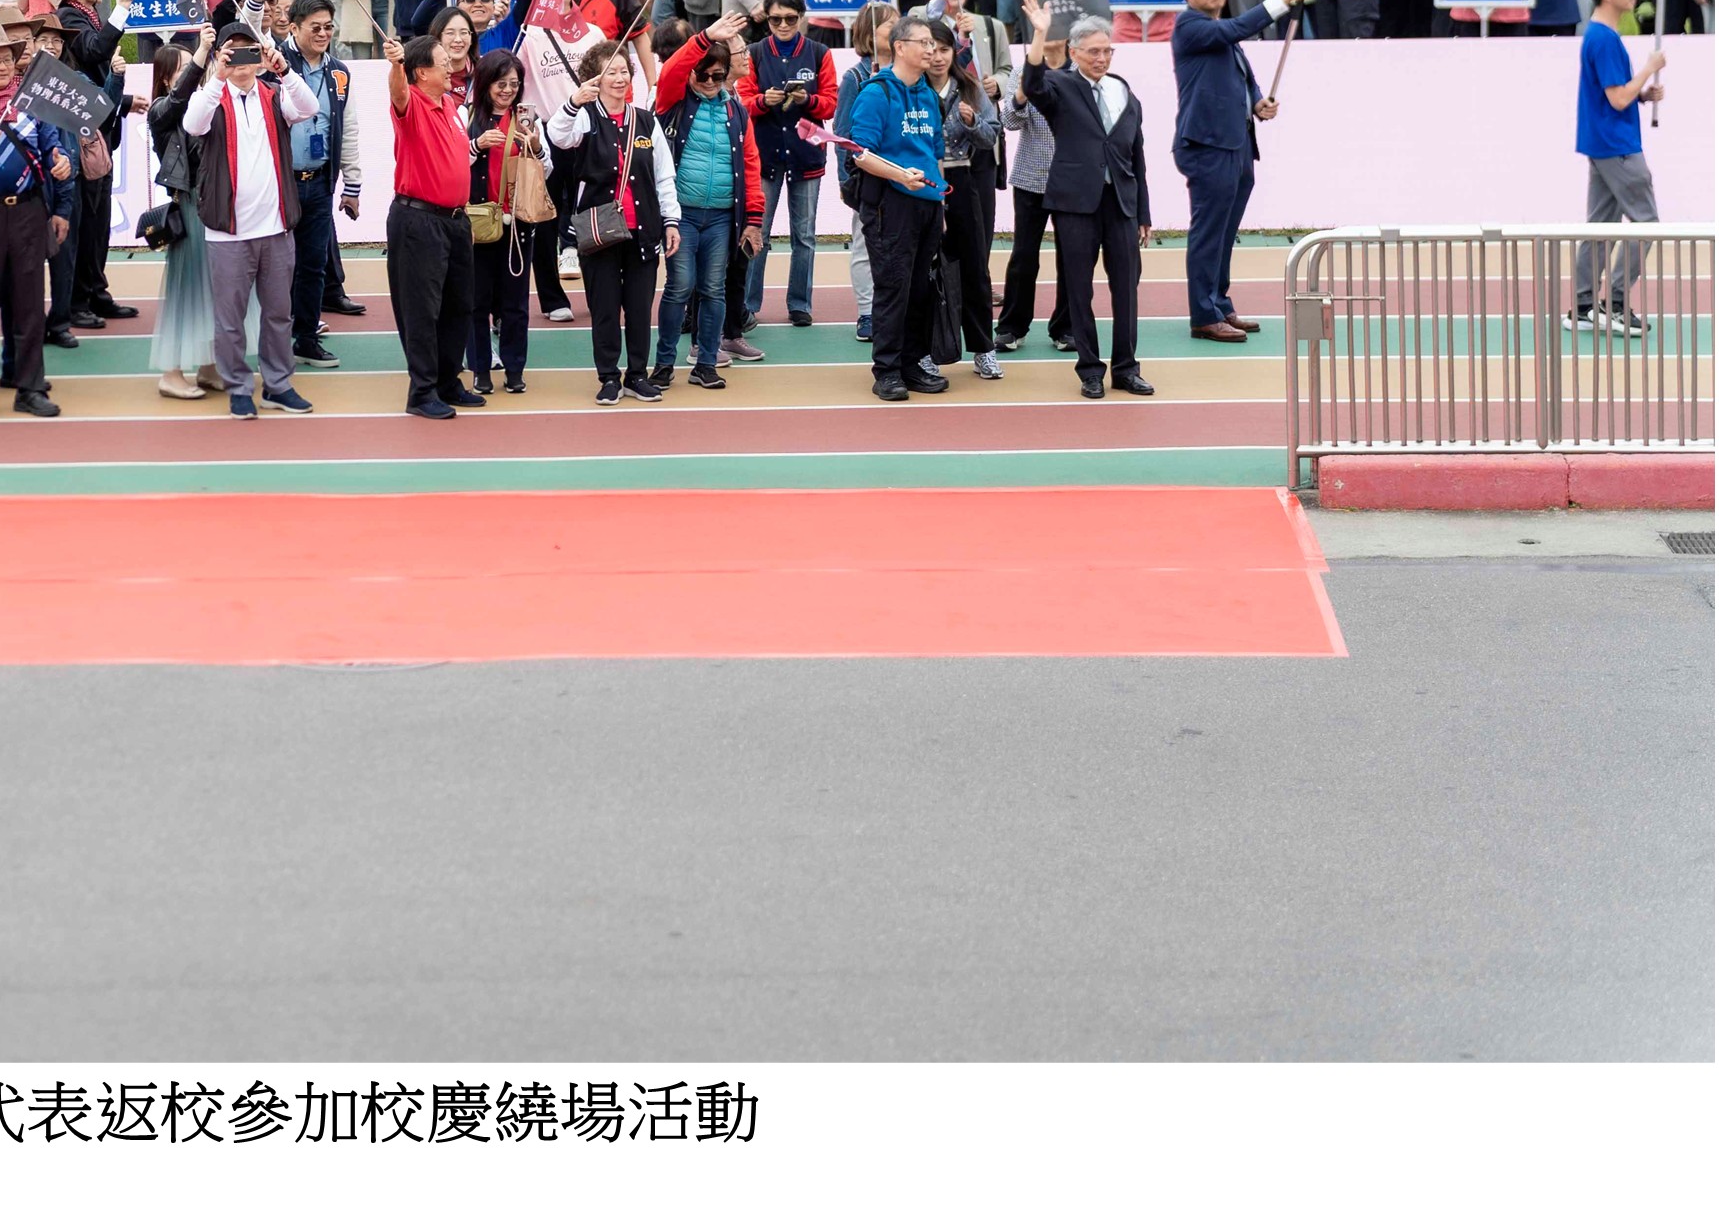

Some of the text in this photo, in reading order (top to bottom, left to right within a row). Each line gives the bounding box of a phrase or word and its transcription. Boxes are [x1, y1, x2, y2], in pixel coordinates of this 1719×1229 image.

[795, 71, 815, 81] SCU
[30, 82, 93, 121] 物理系系友會
[48, 76, 89, 107] 東吳大學
[633, 139, 652, 149] SCU
